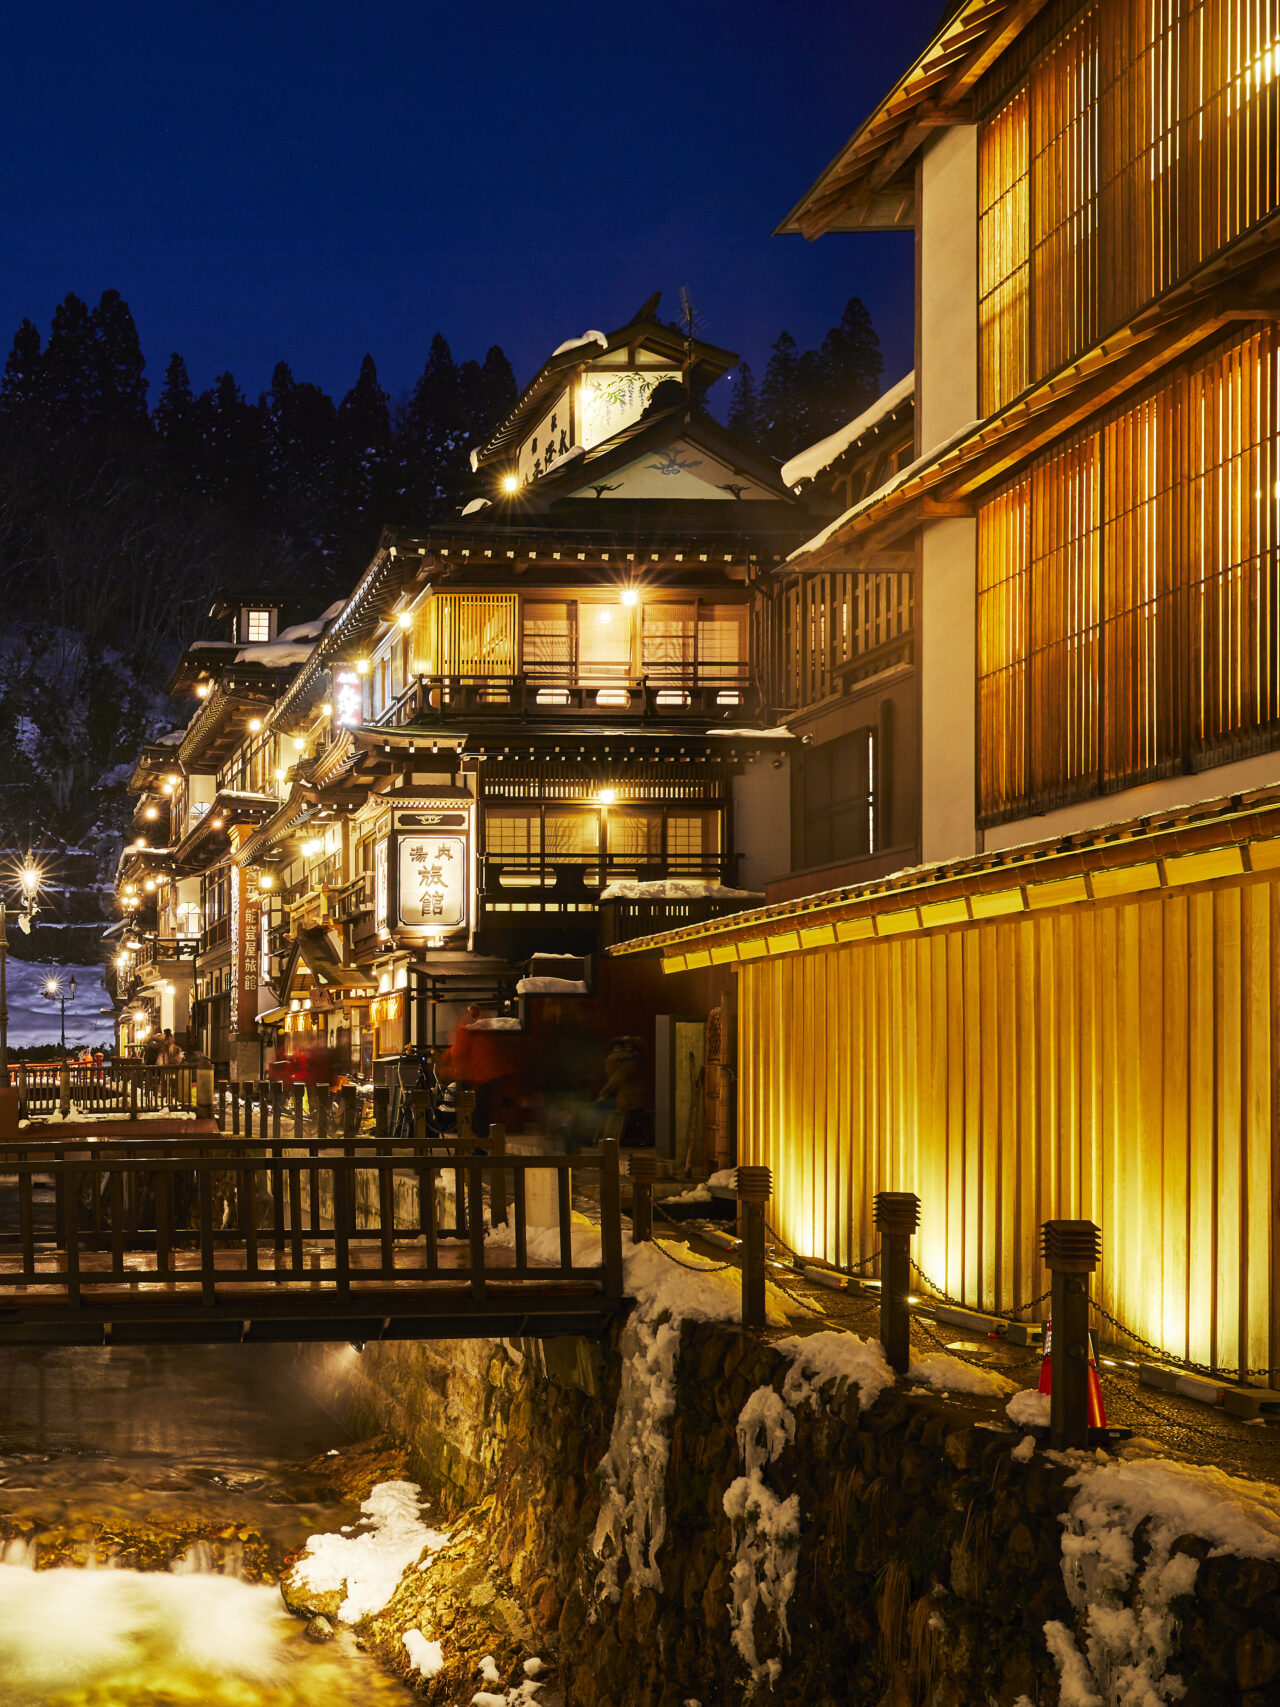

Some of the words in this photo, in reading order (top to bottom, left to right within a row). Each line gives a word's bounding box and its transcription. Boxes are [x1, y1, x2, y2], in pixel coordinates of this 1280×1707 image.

[244, 908, 257, 990] 能登屋旅館
